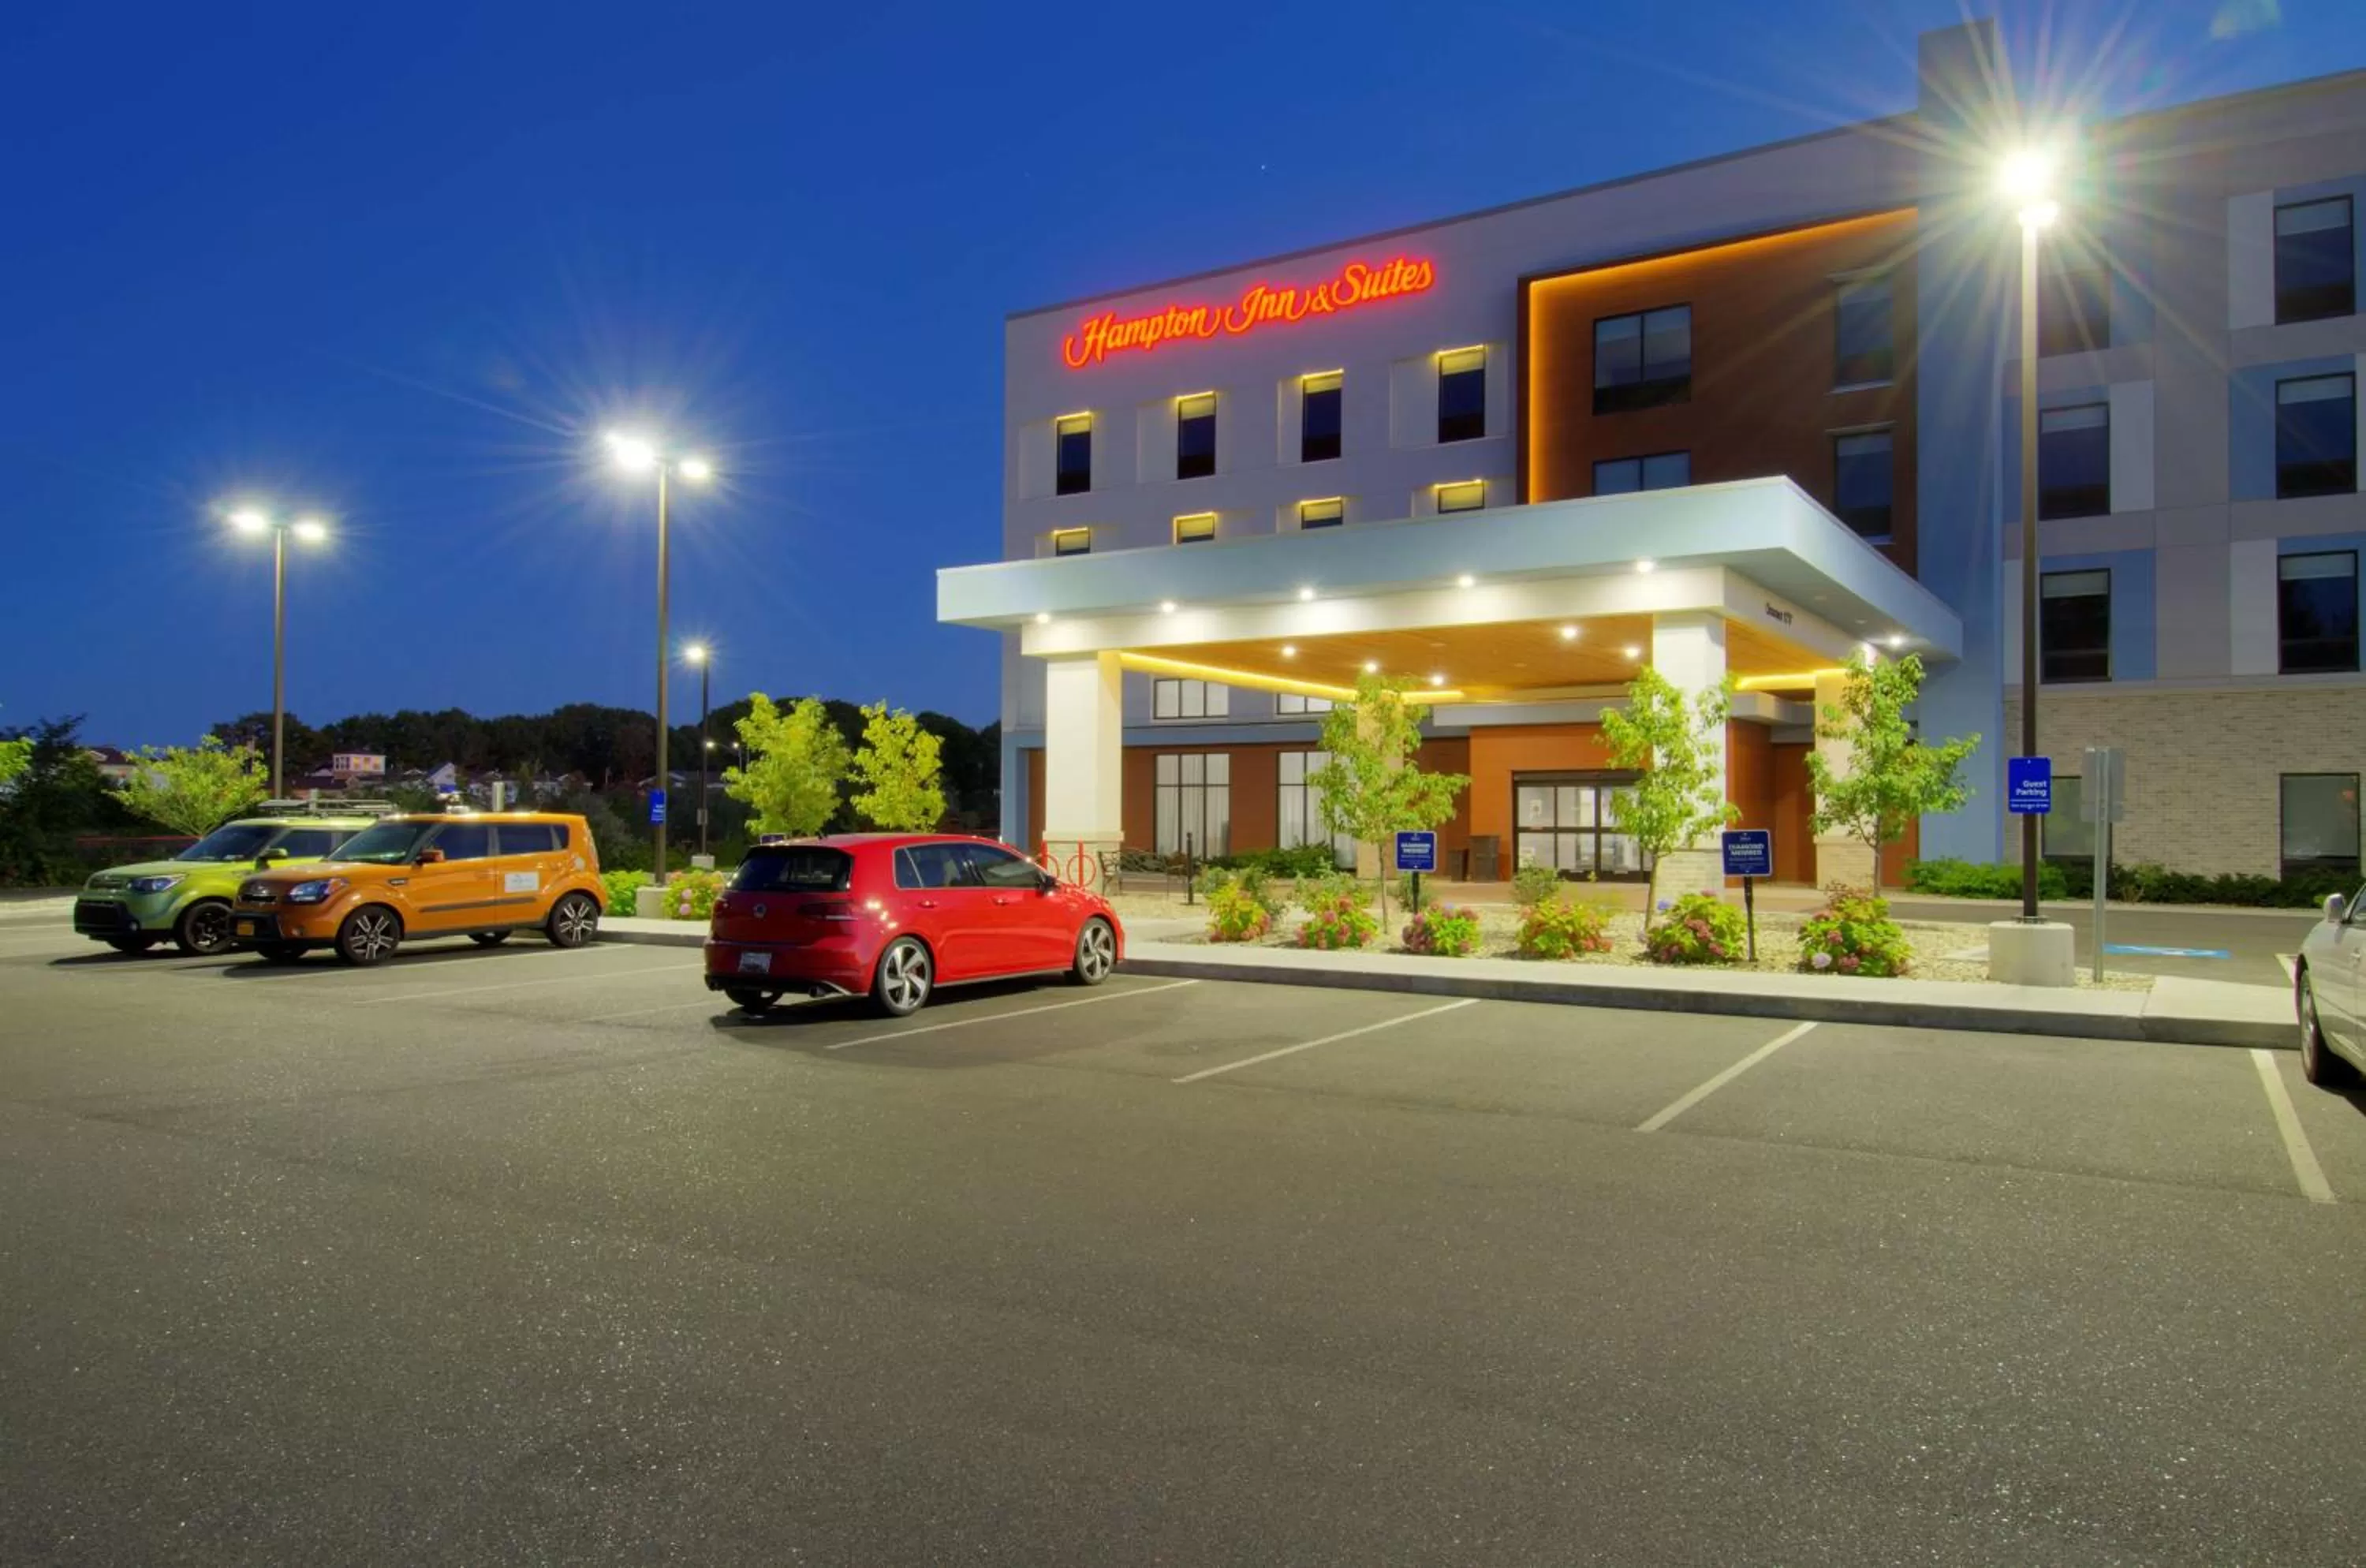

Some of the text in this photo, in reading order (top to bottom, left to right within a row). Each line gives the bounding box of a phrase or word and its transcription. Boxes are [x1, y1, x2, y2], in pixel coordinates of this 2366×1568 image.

[1065, 258, 1434, 368] Hampton Inn & Suites
[2016, 789, 2047, 797] Parking
